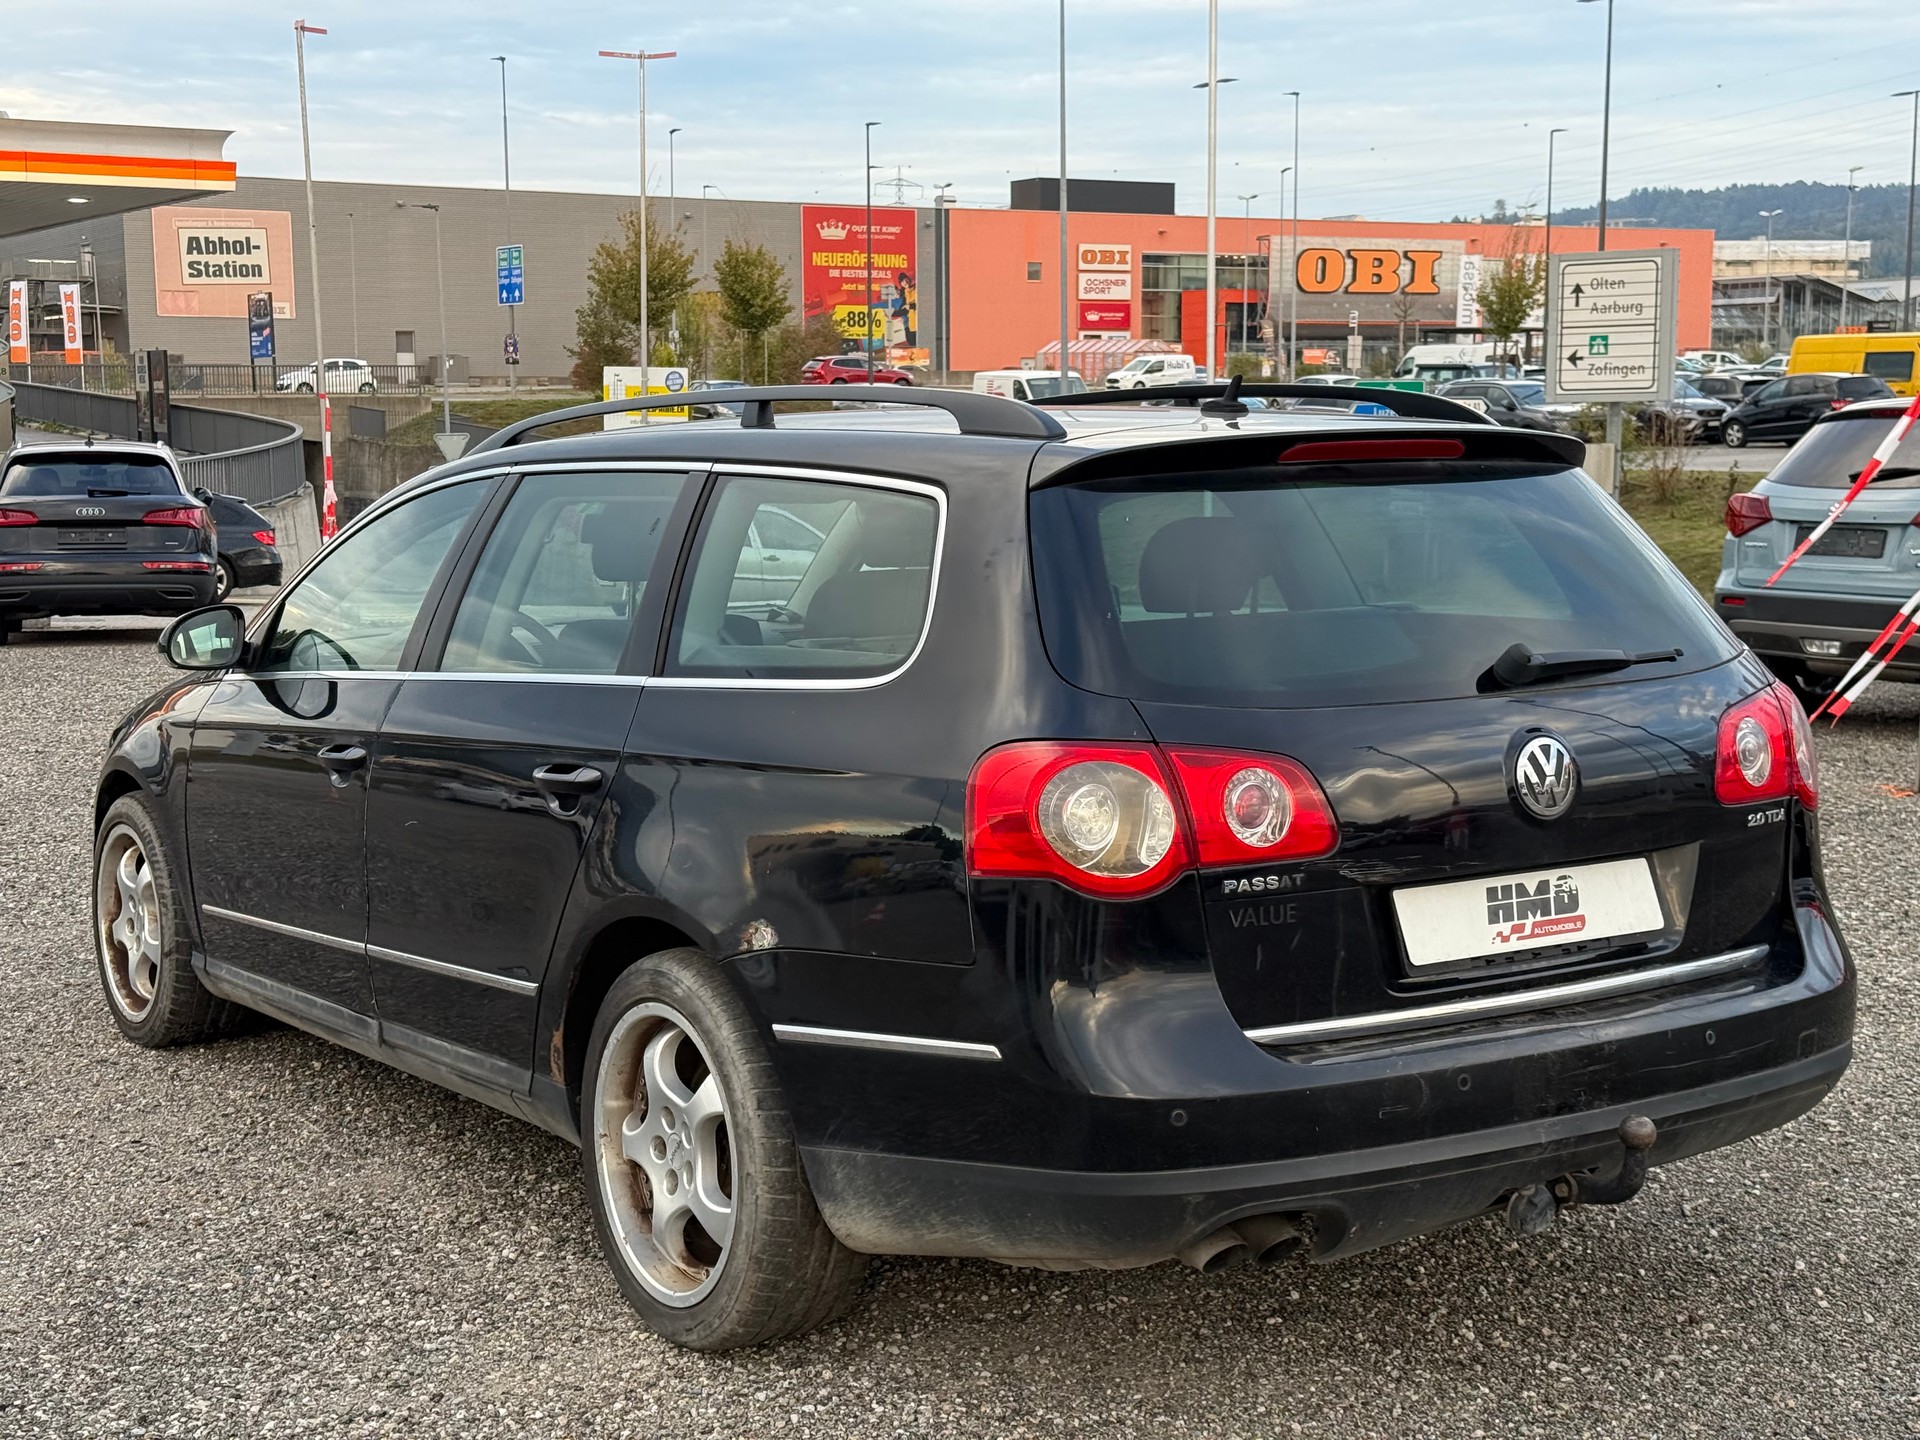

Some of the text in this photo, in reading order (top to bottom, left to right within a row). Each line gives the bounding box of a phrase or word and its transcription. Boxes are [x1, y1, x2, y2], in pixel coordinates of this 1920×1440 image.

[851, 225, 881, 234] OUTET
[186, 236, 261, 255] Abhol-
[1081, 249, 1129, 265] OBI
[187, 260, 263, 278] Station
[828, 269, 841, 278] DIE
[1296, 248, 1442, 295] OBI
[1083, 286, 1111, 294] SPORT
[1085, 278, 1127, 287] OCHSNER
[1590, 277, 1625, 290] Olten
[10, 288, 21, 341] OBI
[1590, 301, 1643, 316] Aarburg
[1588, 362, 1645, 378] Zofingen
[1765, 807, 1785, 823] TDI
[1223, 873, 1305, 893] PASSAT
[1229, 903, 1297, 928] VALUE
[1534, 921, 1584, 934] AUTOMOBILE
